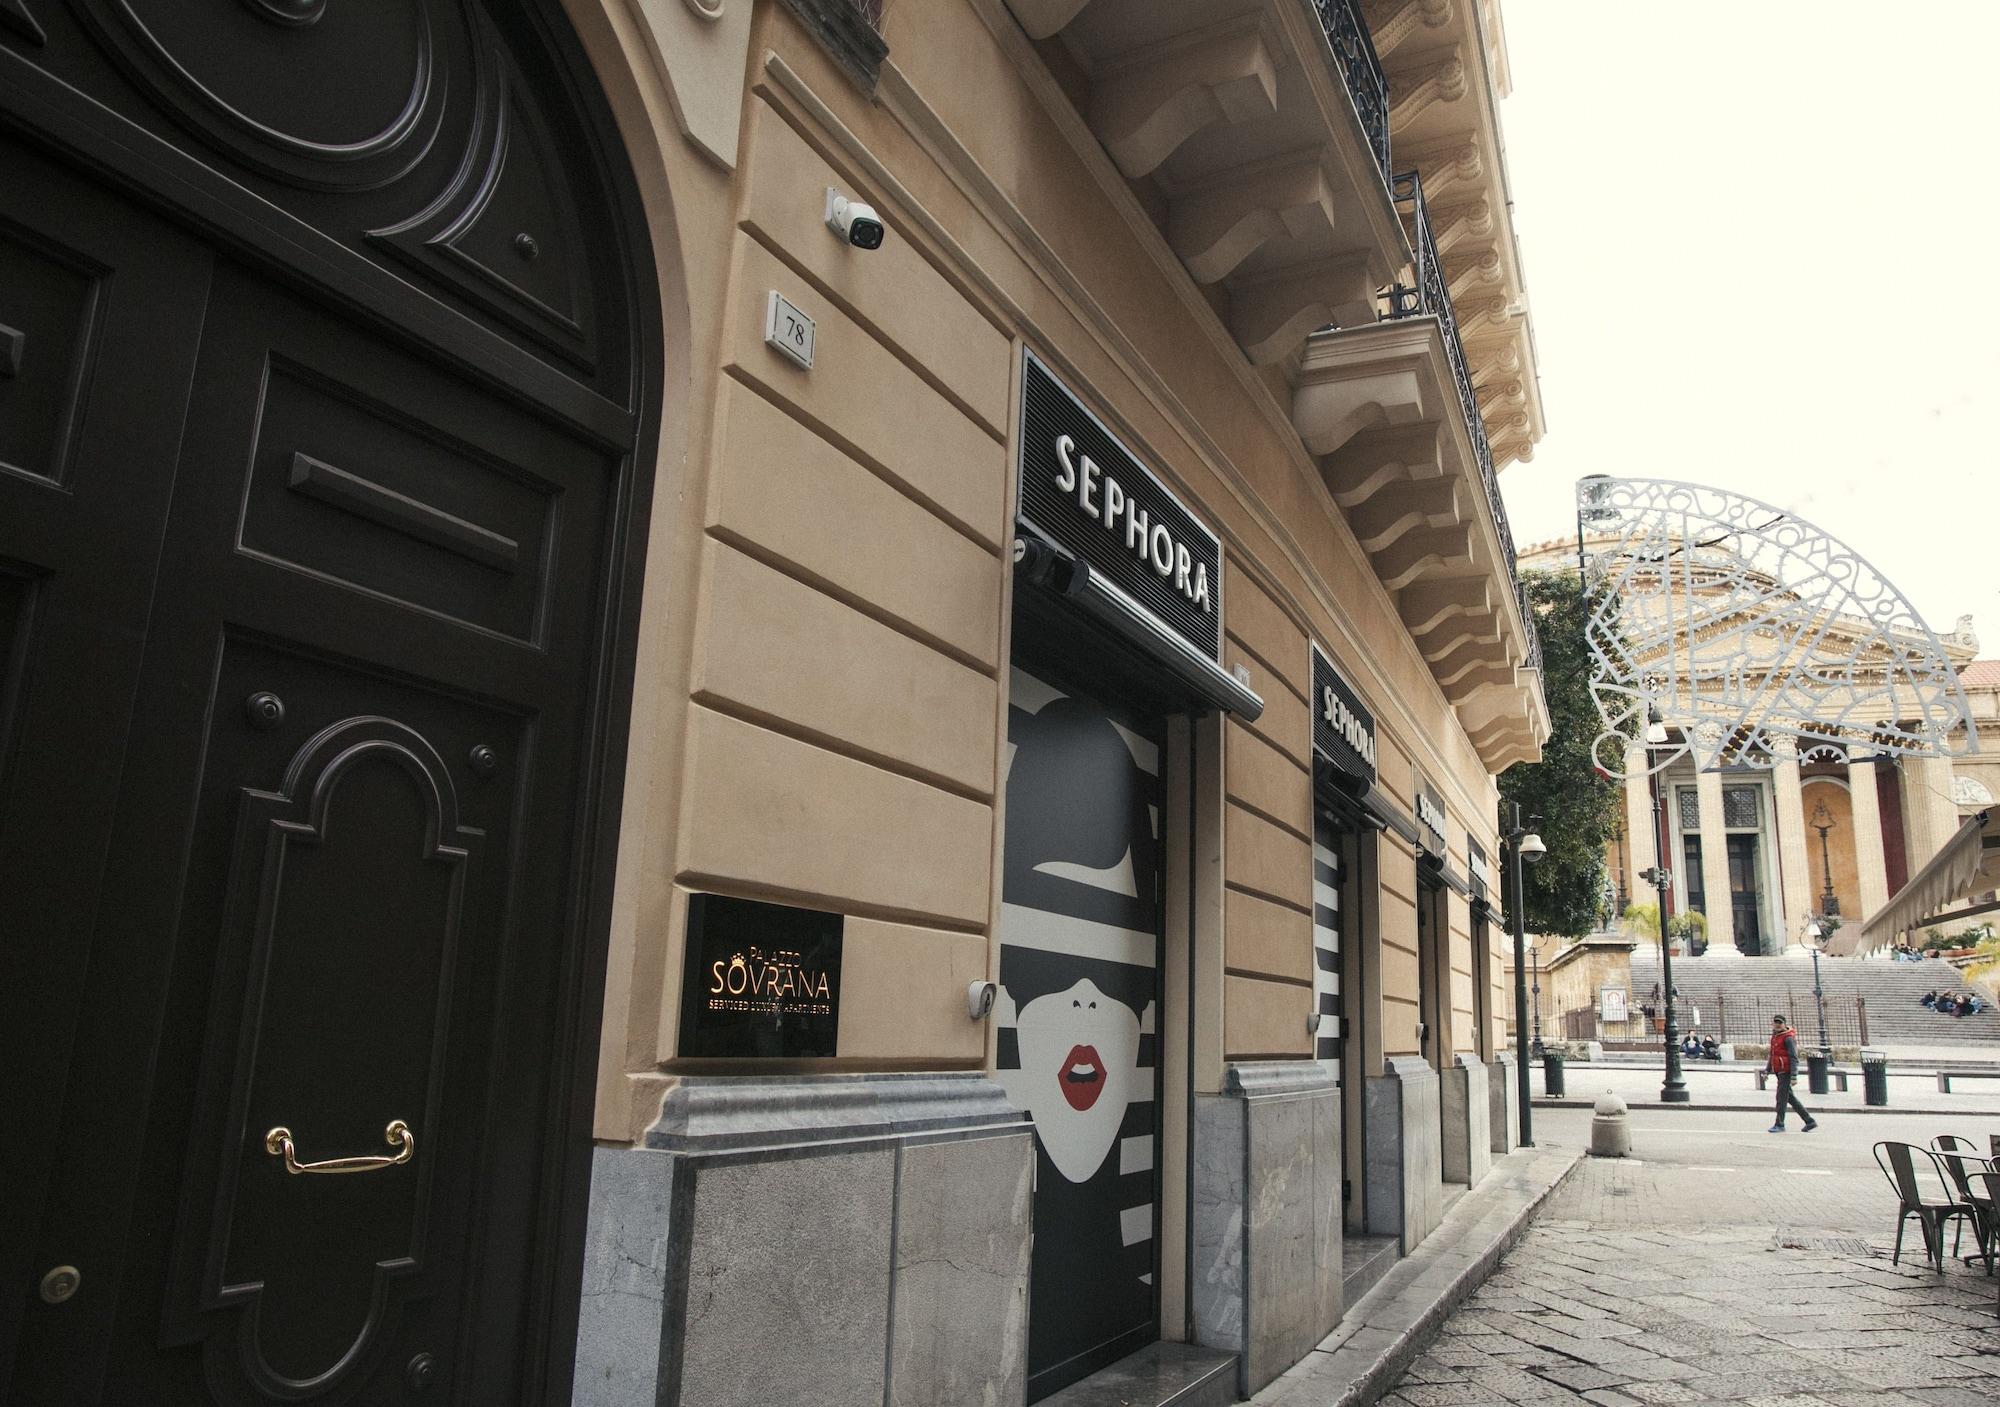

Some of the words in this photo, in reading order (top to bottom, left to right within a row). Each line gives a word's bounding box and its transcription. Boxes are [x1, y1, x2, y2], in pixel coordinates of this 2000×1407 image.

[786, 314, 805, 346] 78
[1055, 434, 1211, 612] SEPHORA
[1324, 685, 1375, 768] SEPHORA
[750, 946, 801, 967] PALAZZO
[711, 960, 830, 999] SOVRANA
